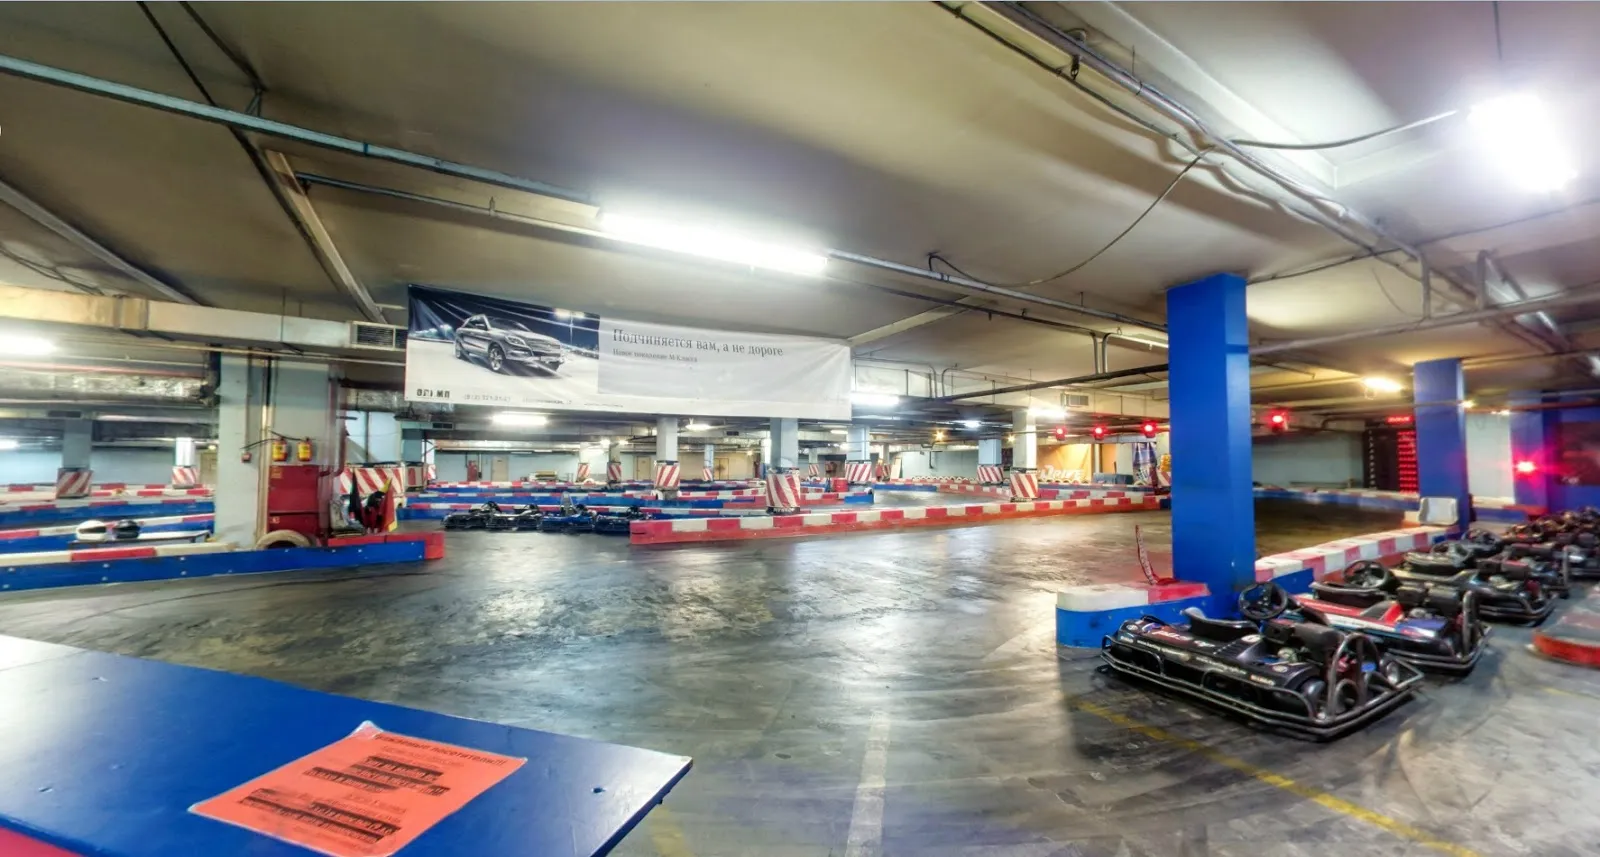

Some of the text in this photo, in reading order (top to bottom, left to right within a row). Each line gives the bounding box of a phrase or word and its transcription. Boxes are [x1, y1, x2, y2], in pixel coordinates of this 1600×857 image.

[613, 328, 784, 357] Подчиняется вам, а не дороге
